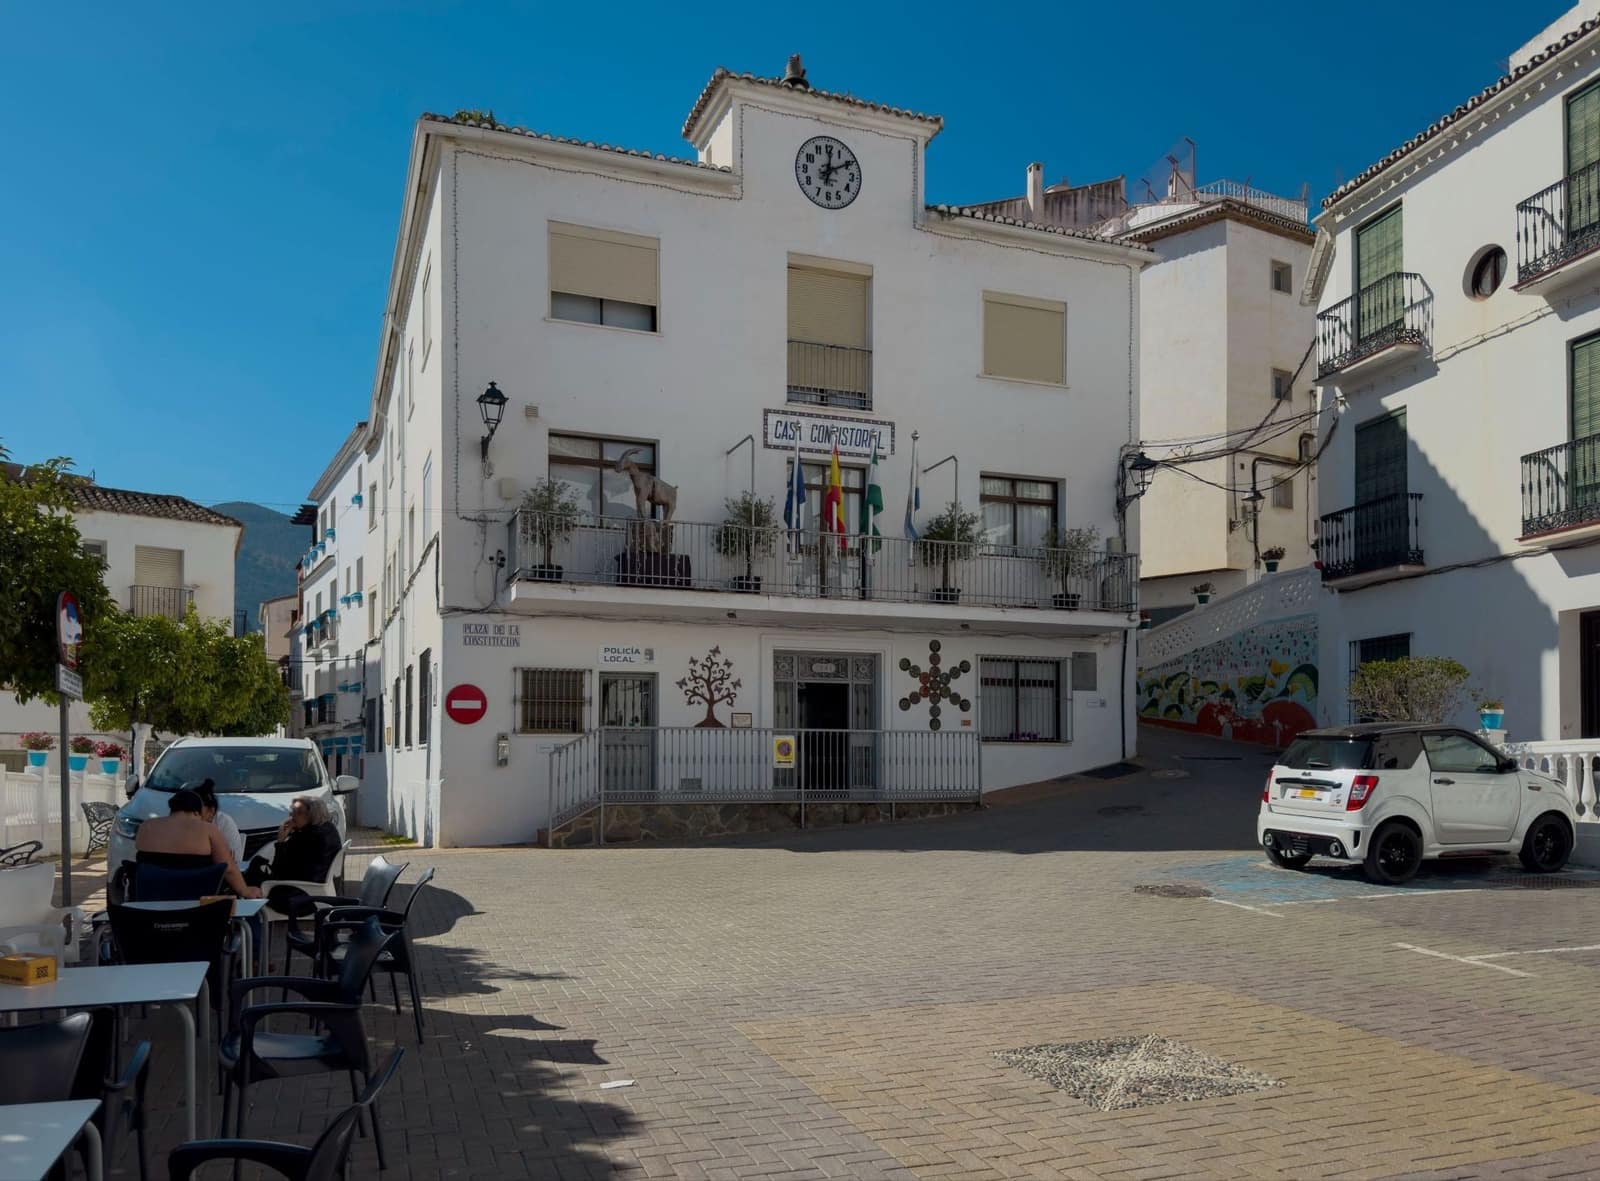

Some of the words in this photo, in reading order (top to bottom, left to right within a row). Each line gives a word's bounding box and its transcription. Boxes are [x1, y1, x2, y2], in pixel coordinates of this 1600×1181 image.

[815, 145, 822, 155] 11
[825, 144, 834, 155] 12
[838, 150, 841, 159] 1
[806, 153, 815, 163] 10
[802, 164, 808, 174] 9
[805, 176, 812, 186] 8
[849, 173, 855, 183] 3
[816, 187, 821, 197] 7
[844, 183, 850, 192] 4
[825, 192, 832, 201] 6
[835, 191, 842, 200] 5
[810, 424, 885, 449] CONISTORIL
[463, 623, 489, 635] PLAZA
[494, 624, 505, 635] DE
[508, 624, 520, 636] LA
[603, 646, 641, 655] POLICÍA
[603, 655, 635, 663] LOCAL
